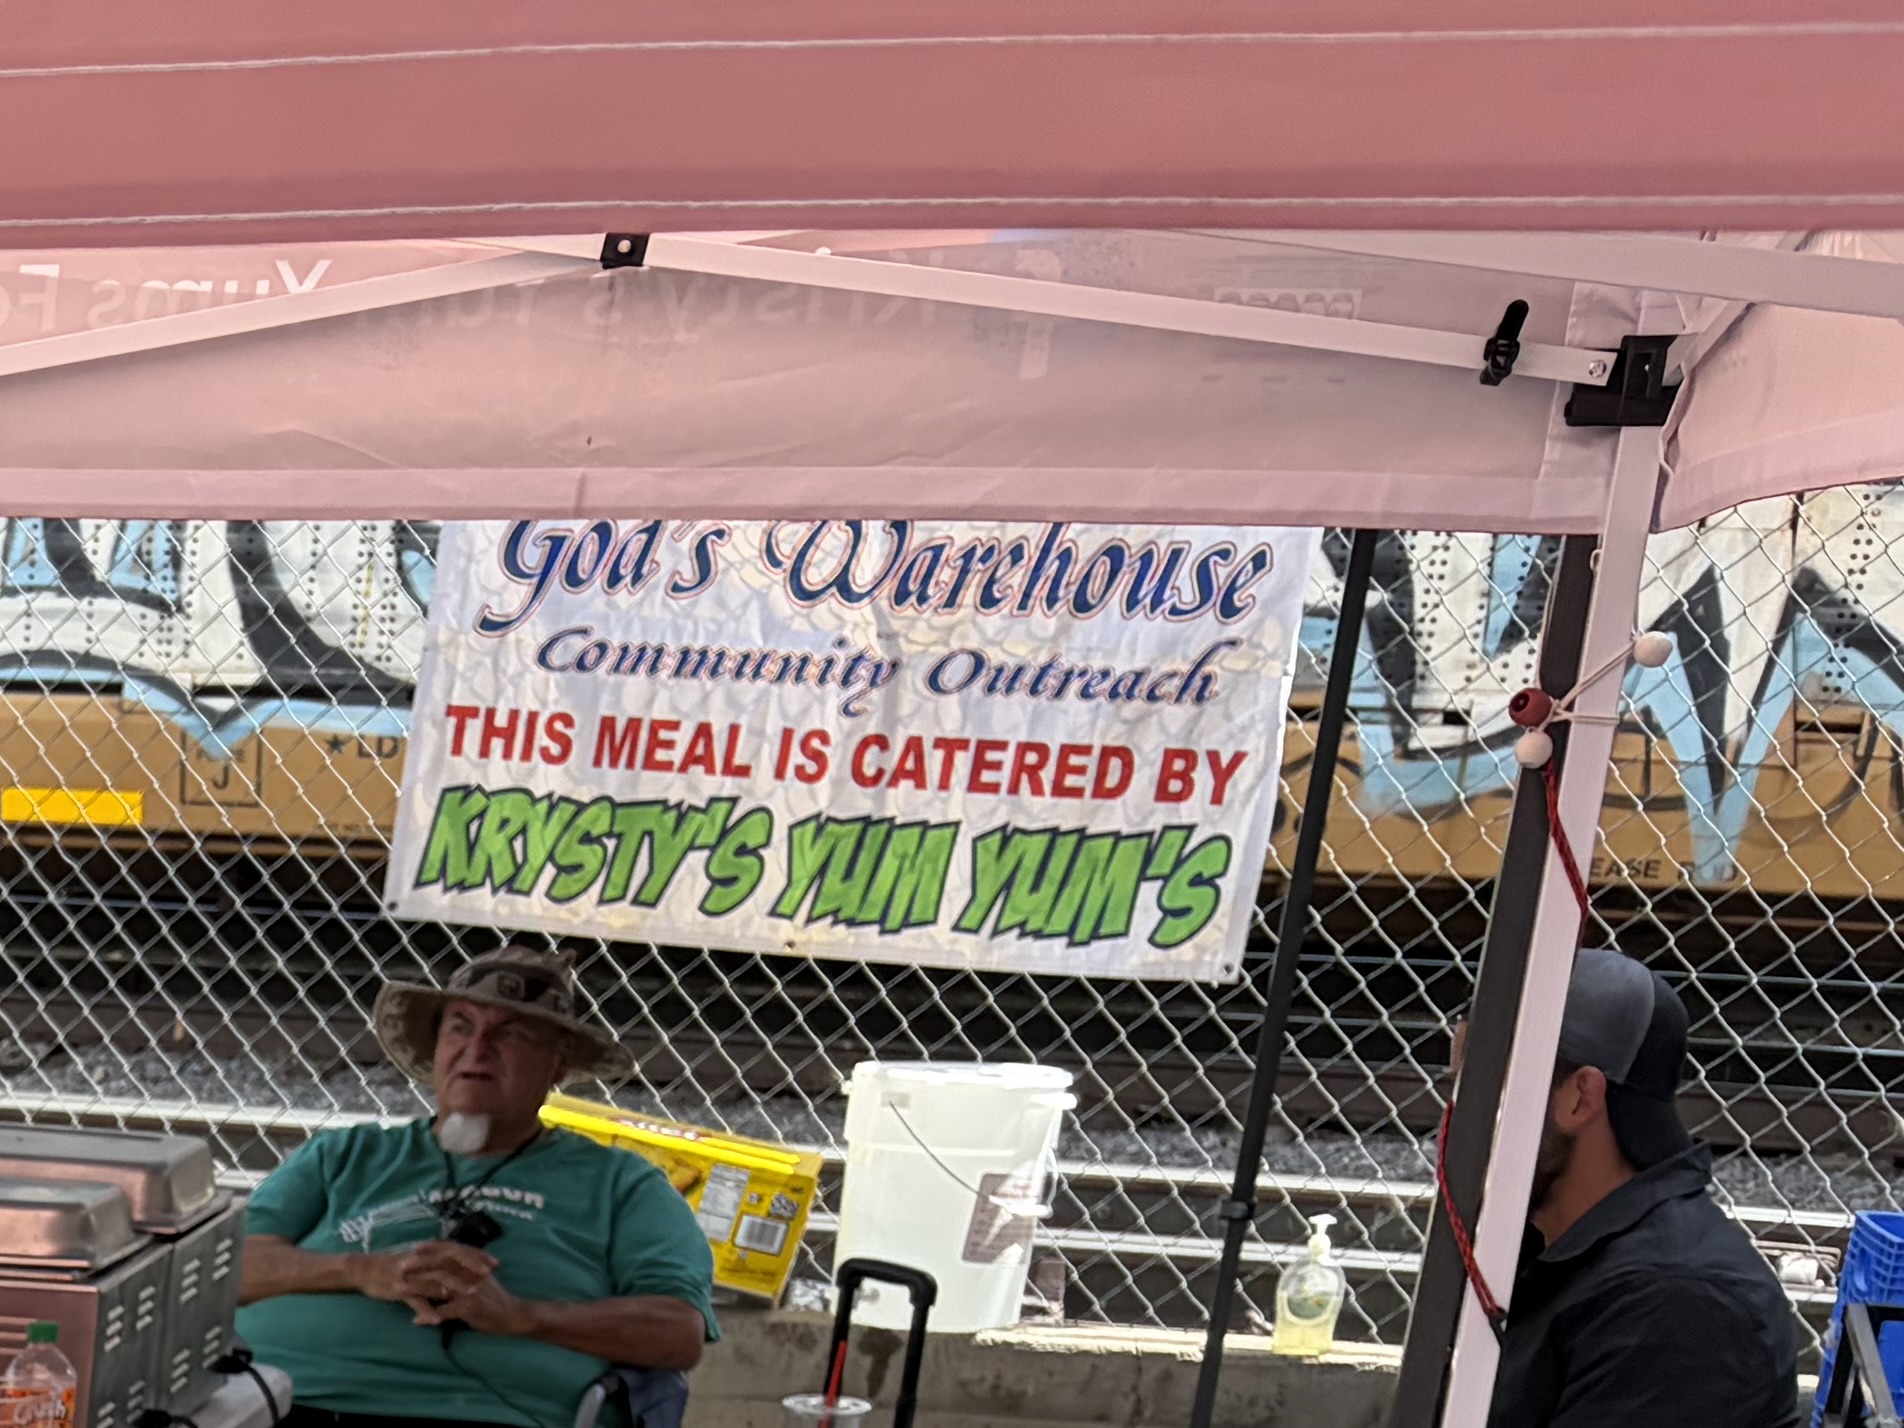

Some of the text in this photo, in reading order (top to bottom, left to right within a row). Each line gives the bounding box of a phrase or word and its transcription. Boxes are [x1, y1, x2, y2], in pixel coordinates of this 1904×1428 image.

[762, 519, 1275, 625] Warehouse
[536, 625, 1244, 718] Community Outreach
[445, 704, 1249, 807] THIS MEAL IS CATERED BY
[414, 783, 1233, 950] KRYSTY'S YUM YUM'S
